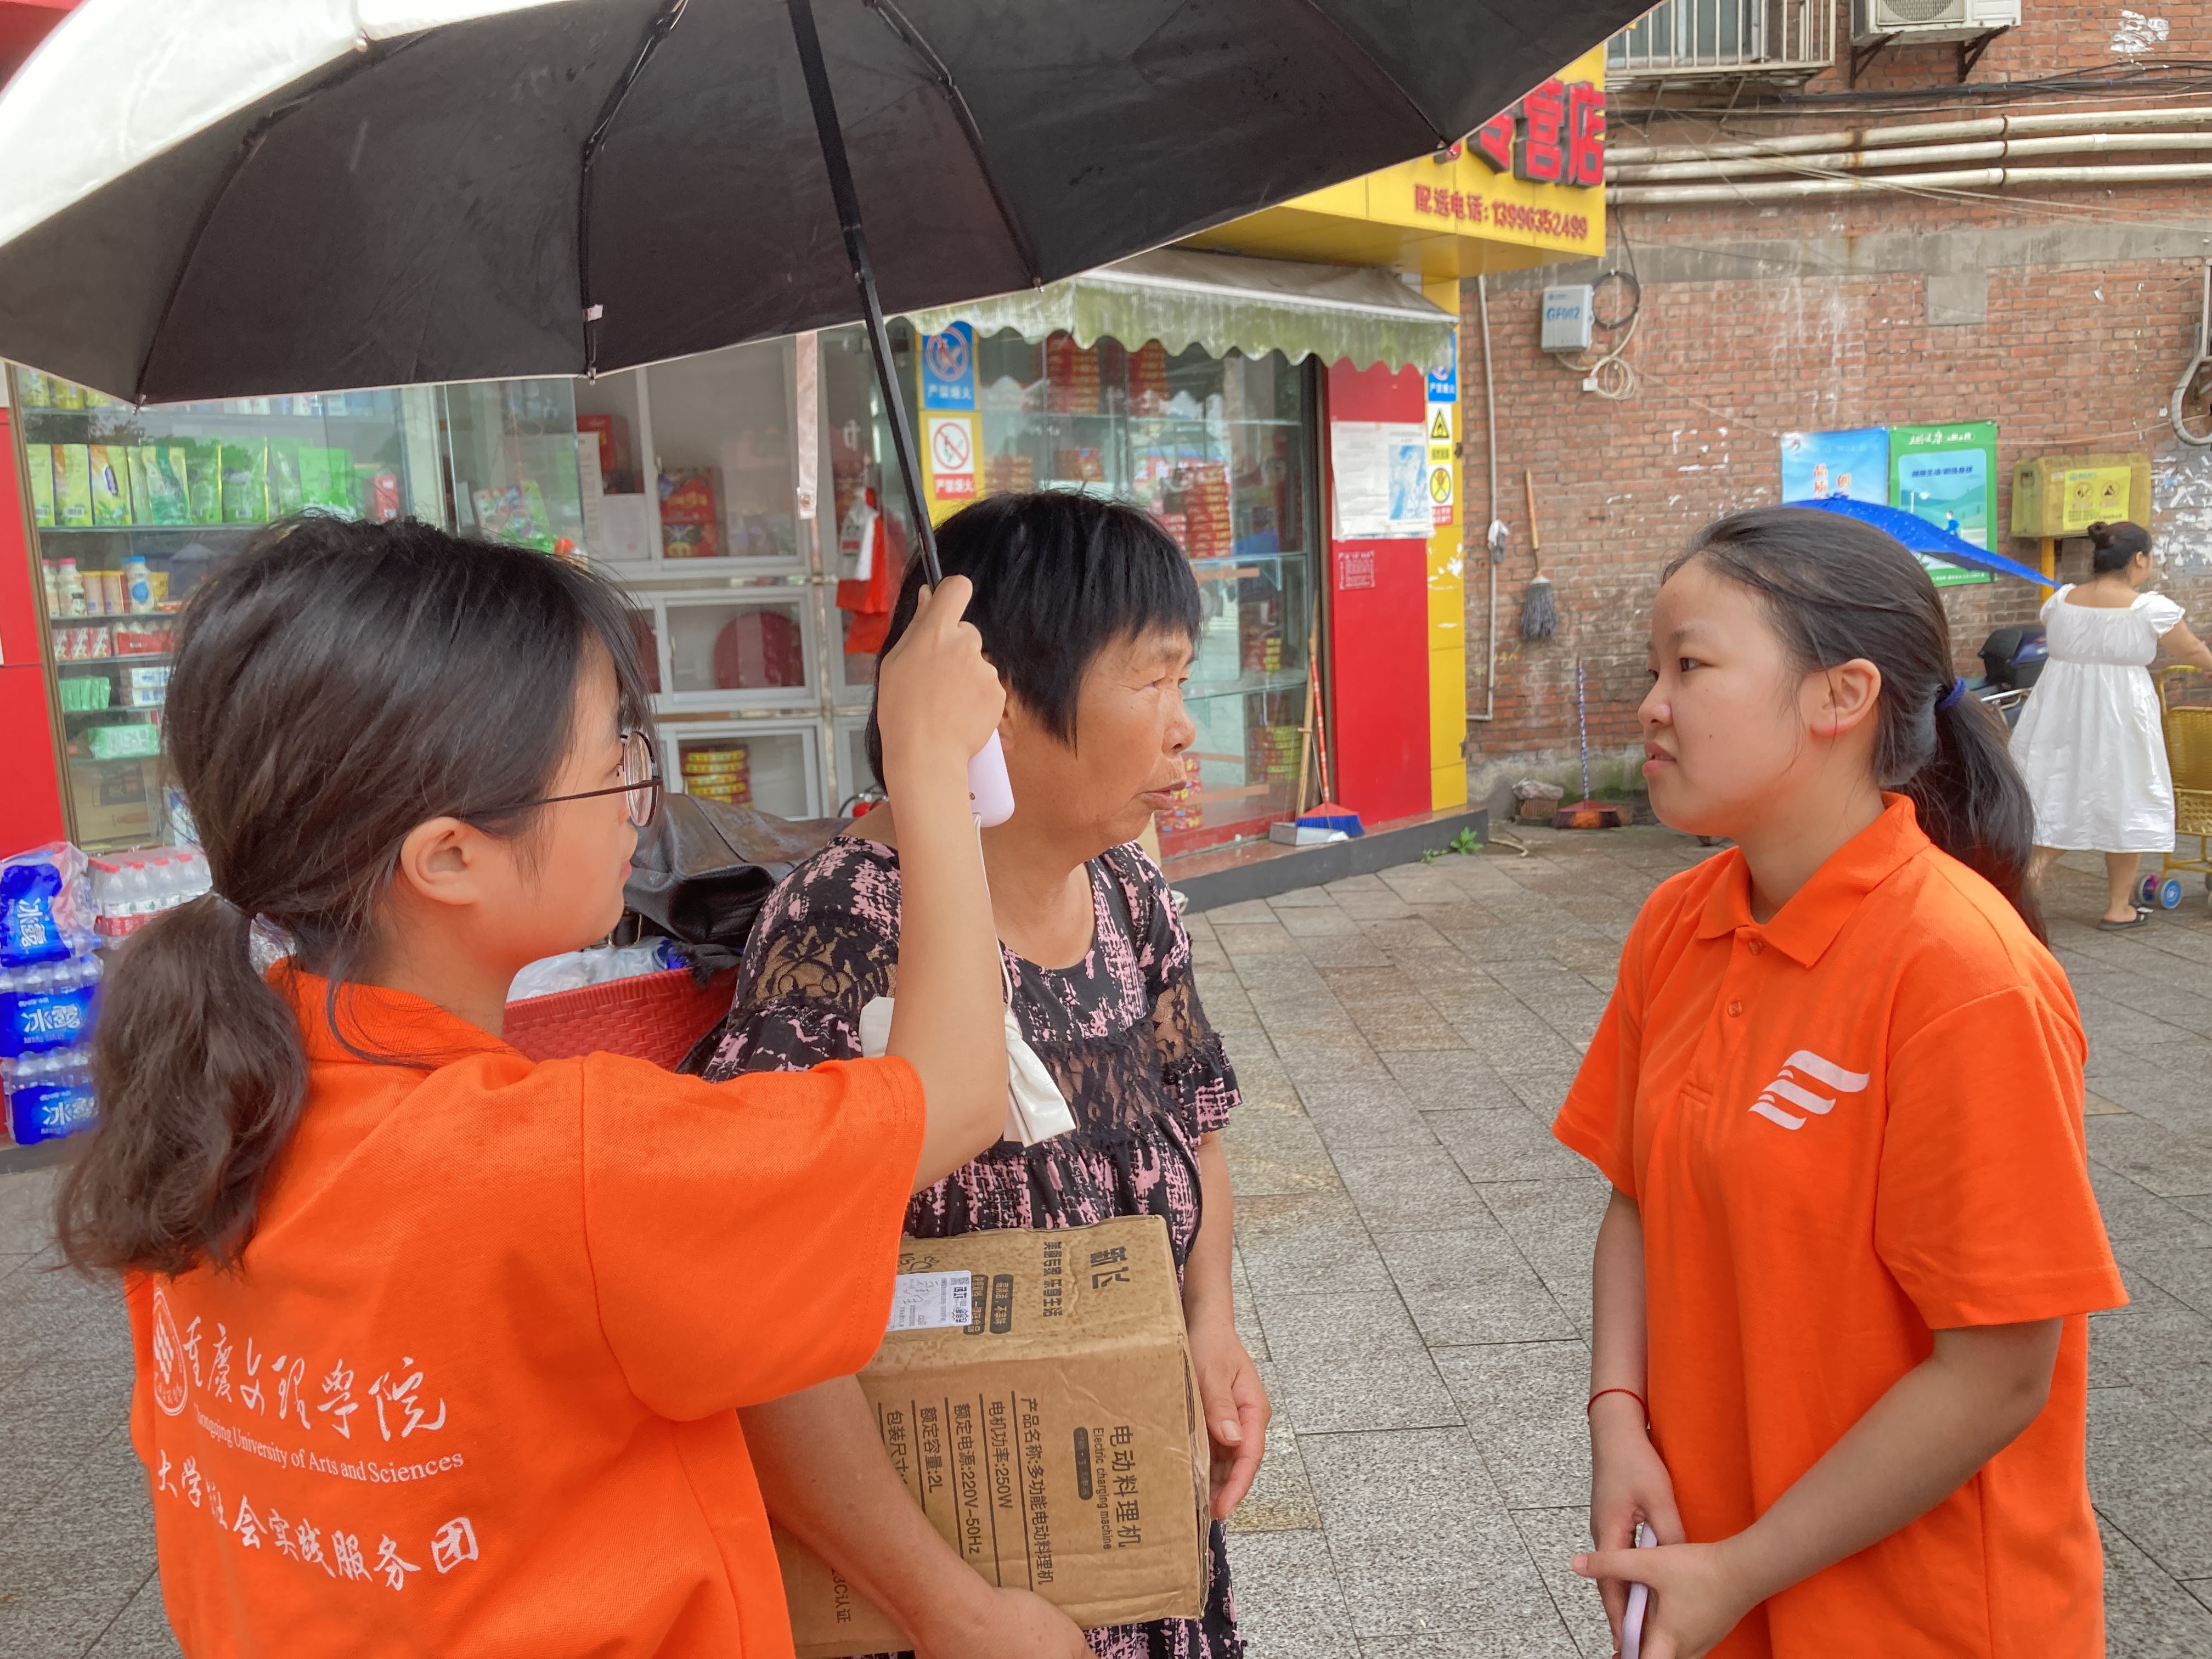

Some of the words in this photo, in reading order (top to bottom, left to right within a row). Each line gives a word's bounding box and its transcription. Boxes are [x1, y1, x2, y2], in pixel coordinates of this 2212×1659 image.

[232, 1426, 287, 1469] University
[291, 1448, 306, 1469] of
[309, 1452, 338, 1475] Arts
[341, 1461, 366, 1481] and
[368, 1453, 464, 1483] Sciences
[920, 1407, 943, 1493] 额定容量:2L
[989, 1401, 1013, 1509] 电机功率:250W
[1093, 1427, 1106, 1464] Electric
[1020, 1397, 1054, 1585] 产品名称:多功能电动料理机
[1096, 1468, 1110, 1509] charging
[1110, 1425, 1142, 1548] 电动料理机
[1100, 1511, 1113, 1550] machine
[831, 1568, 851, 1624] 3C认证
